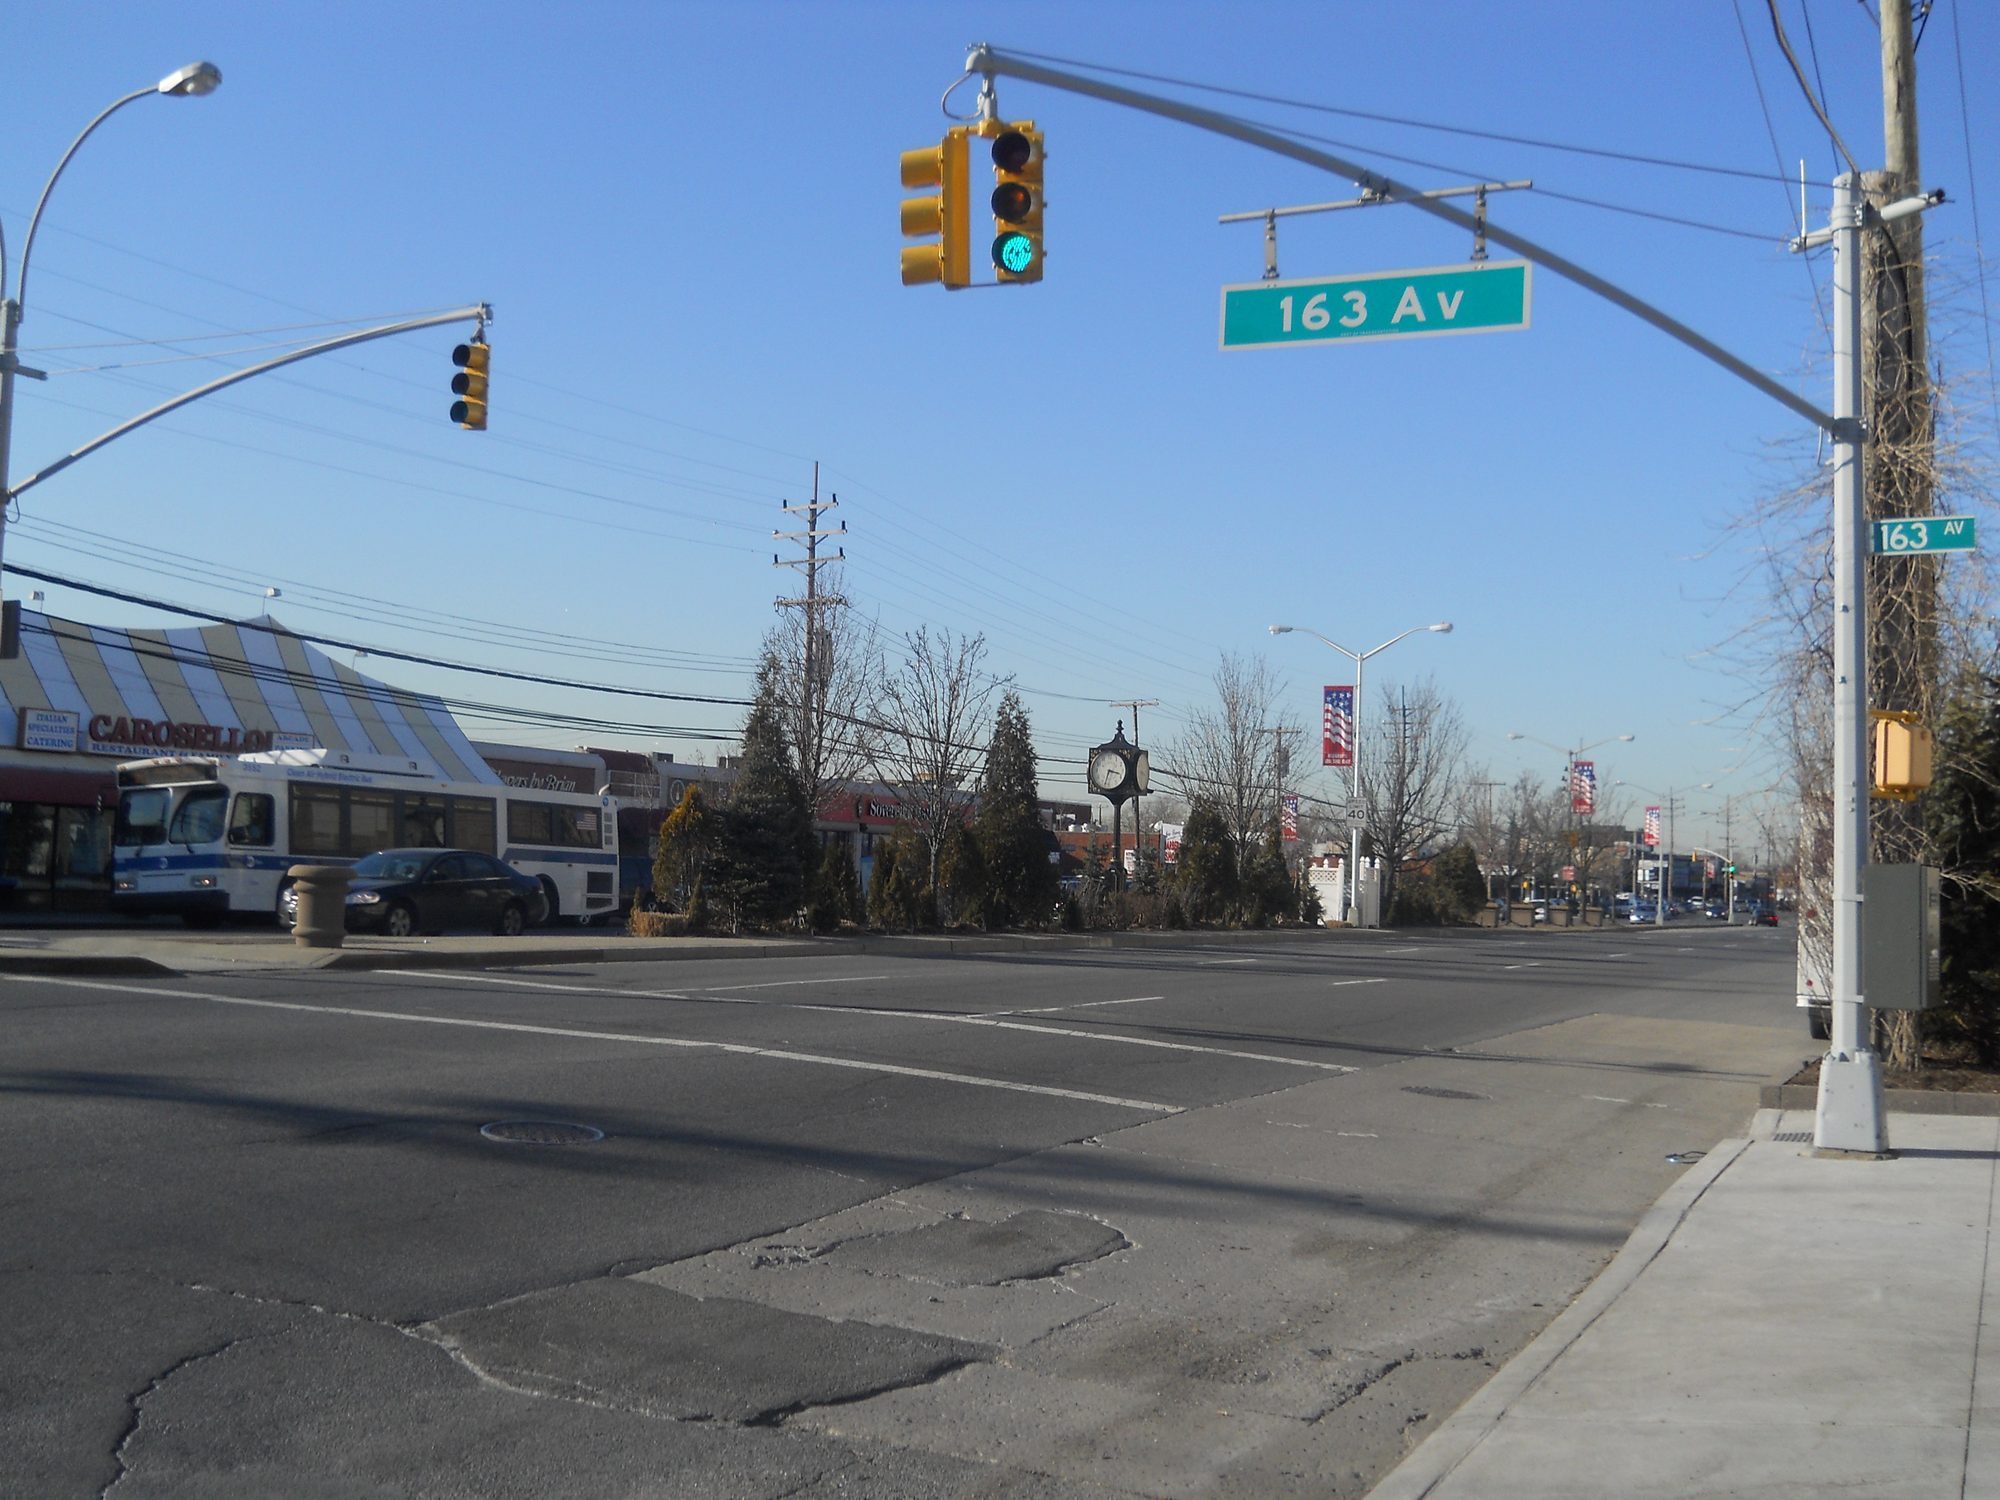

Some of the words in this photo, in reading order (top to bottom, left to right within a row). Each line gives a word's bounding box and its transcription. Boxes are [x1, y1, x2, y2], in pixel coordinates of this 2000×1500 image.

[1280, 290, 1368, 333] 163
[1881, 522, 1928, 551] 163
[1944, 520, 1964, 536] AV
[36, 713, 68, 723] ITALIAN
[27, 736, 73, 749] CATERING
[92, 742, 176, 758] RESTAURANT
[545, 774, 577, 792] Brian
[1348, 809, 1365, 820] 40
